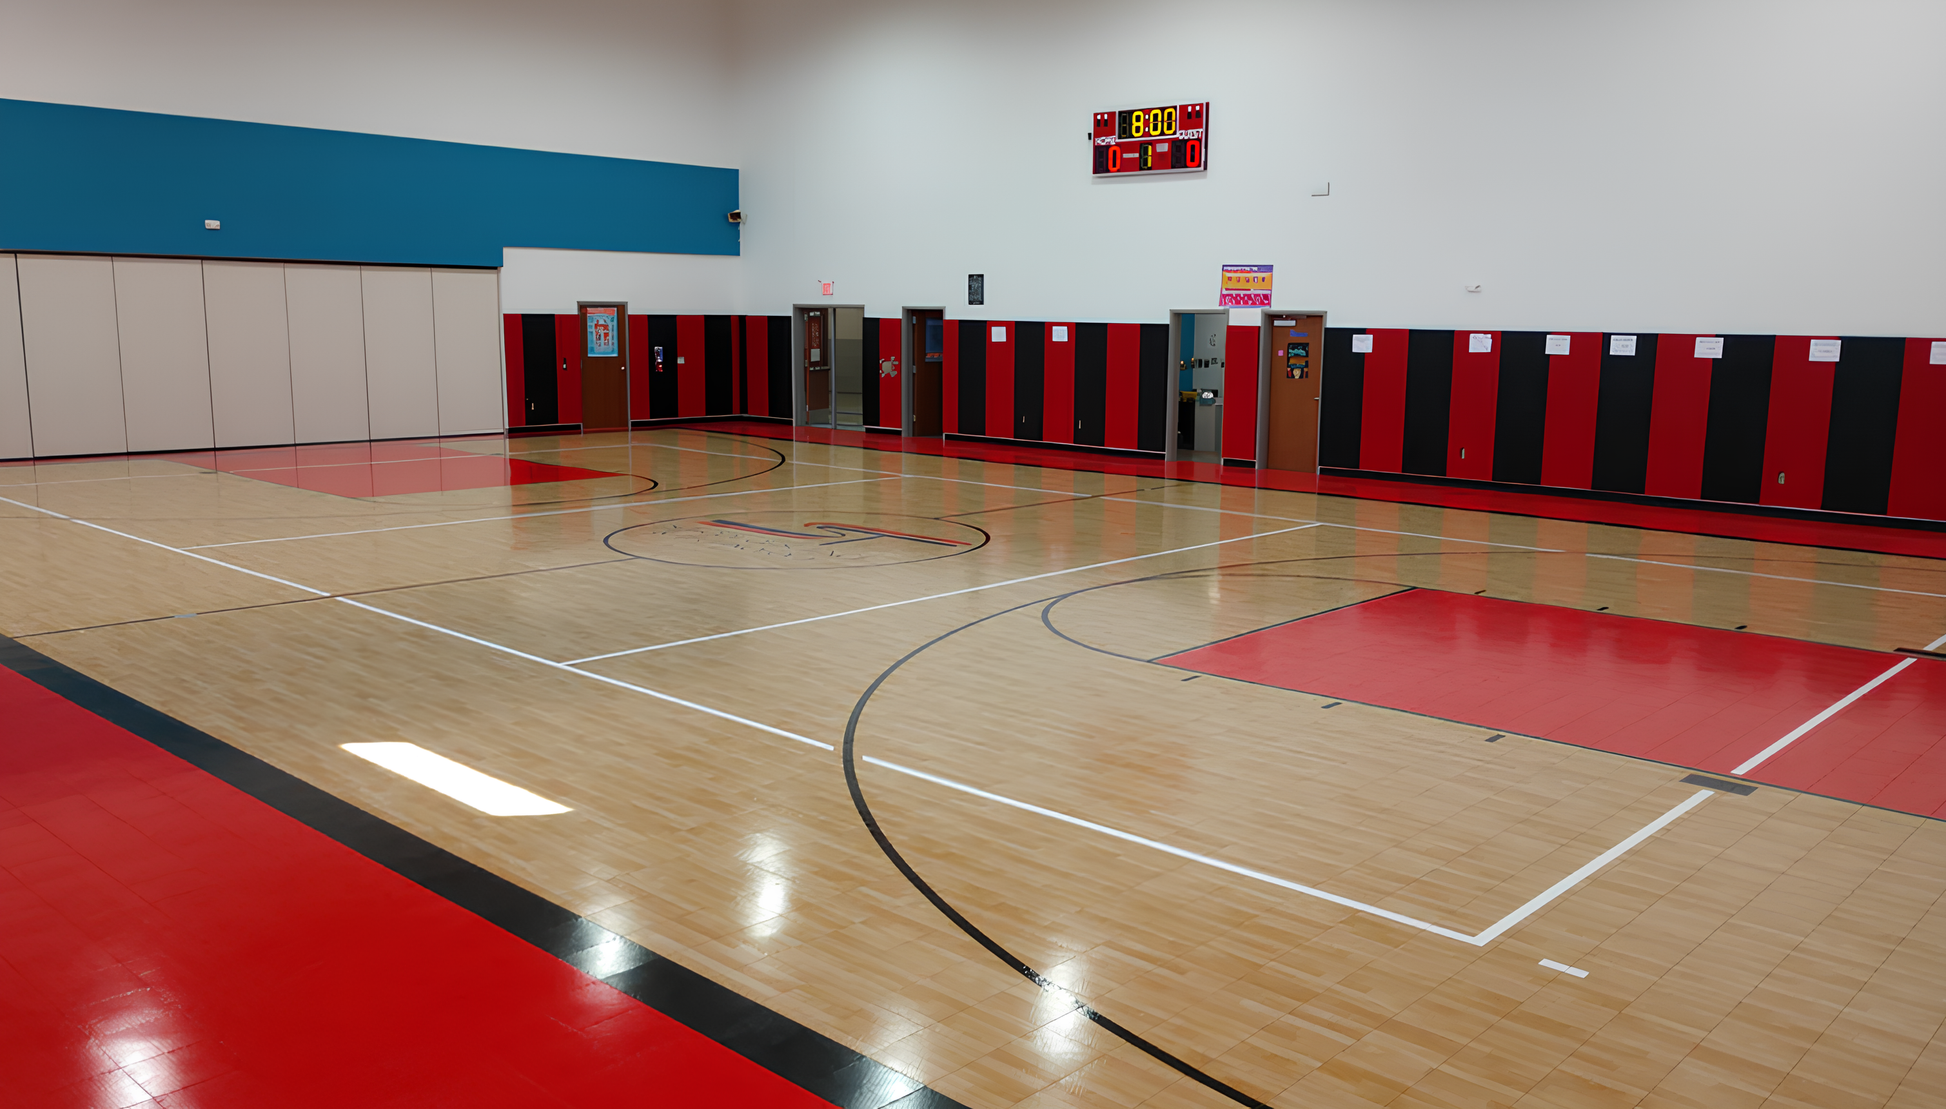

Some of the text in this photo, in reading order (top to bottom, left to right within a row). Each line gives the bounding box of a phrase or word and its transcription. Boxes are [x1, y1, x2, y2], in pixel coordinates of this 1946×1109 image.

[1131, 107, 1176, 138] 8:00
[1107, 145, 1121, 173] 0
[1185, 139, 1201, 168] 0
